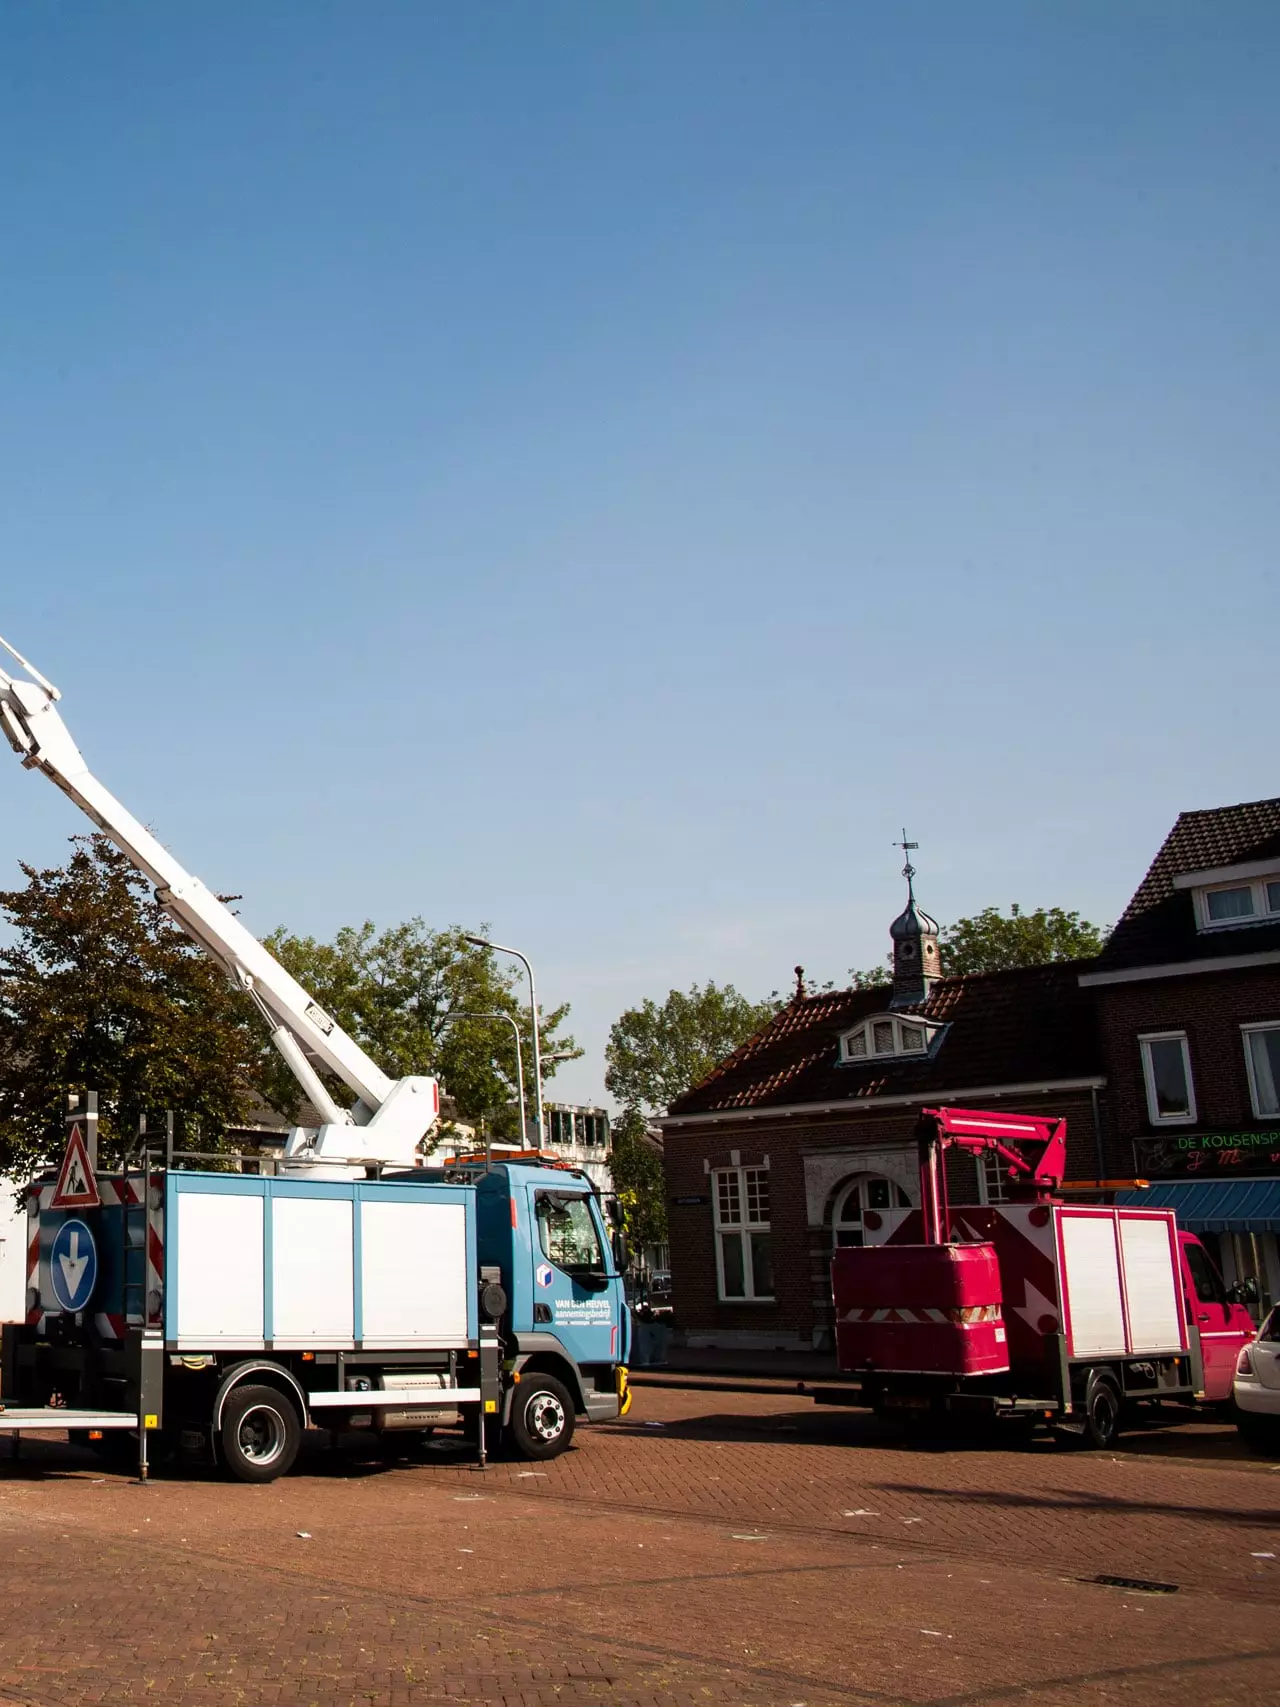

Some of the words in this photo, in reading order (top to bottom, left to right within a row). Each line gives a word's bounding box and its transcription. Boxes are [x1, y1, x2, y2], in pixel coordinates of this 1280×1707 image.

[1178, 1138, 1197, 1149] DE
[1202, 1132, 1280, 1148] KOUSENSP
[555, 1300, 570, 1308] VAN
[586, 1300, 610, 1308] HEUVEL
